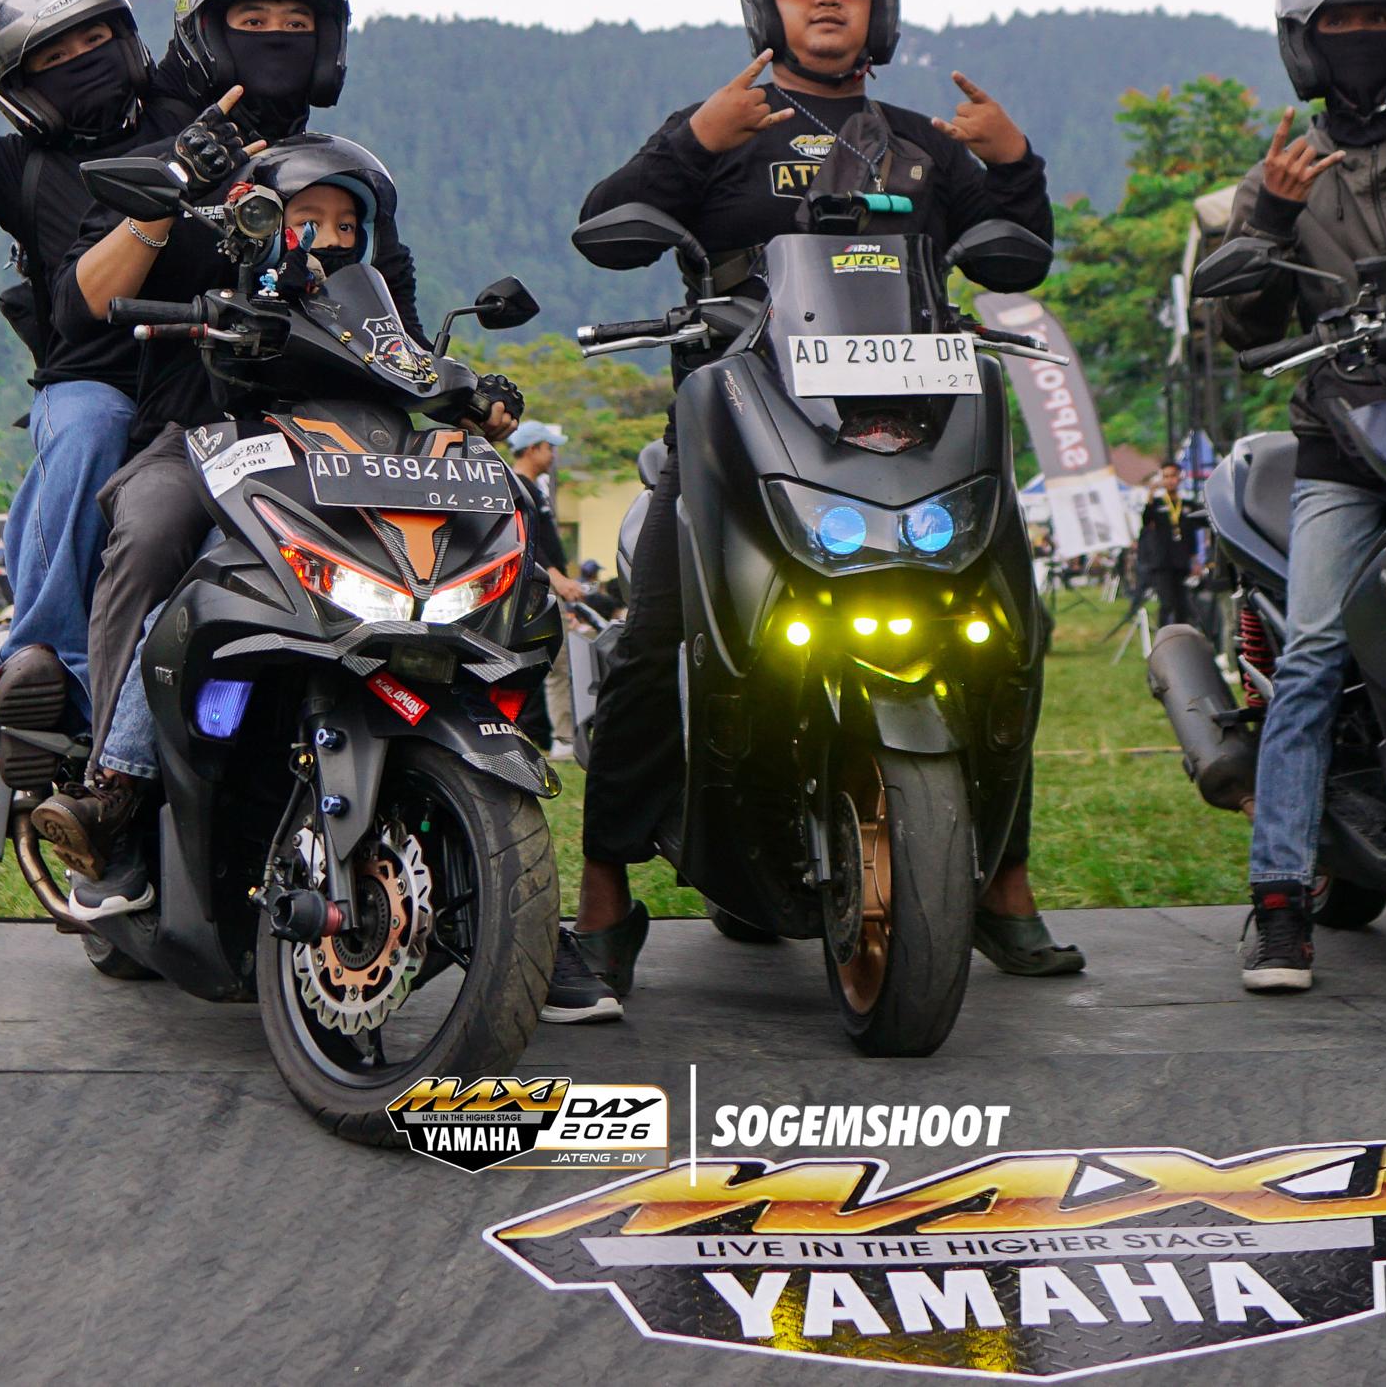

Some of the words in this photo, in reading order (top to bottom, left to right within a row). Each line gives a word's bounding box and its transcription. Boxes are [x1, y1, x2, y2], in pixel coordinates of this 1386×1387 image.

[796, 340, 828, 364] AD
[845, 338, 916, 363] 2302
[936, 337, 969, 362] DR
[316, 454, 350, 477] AD
[697, 1240, 785, 1257] LIVE
[799, 1240, 844, 1257] IN
[856, 1239, 933, 1257] THE
[946, 1234, 1113, 1256] HIGHER
[1121, 1231, 1259, 1252] STAGE
[703, 1260, 1304, 1339] YAMAHA
